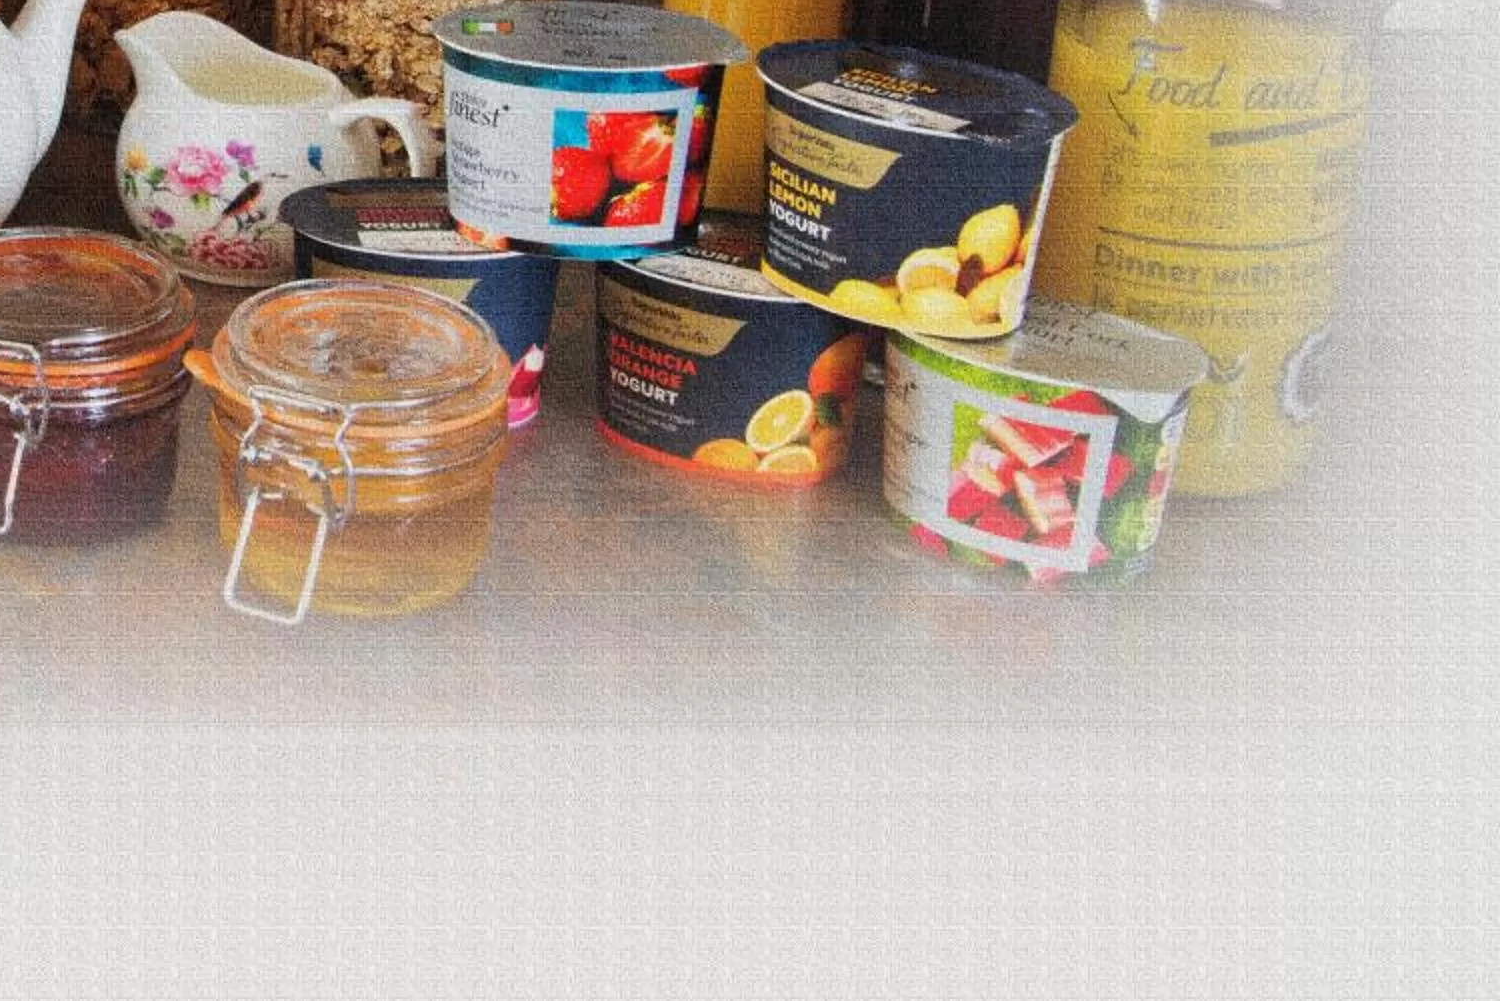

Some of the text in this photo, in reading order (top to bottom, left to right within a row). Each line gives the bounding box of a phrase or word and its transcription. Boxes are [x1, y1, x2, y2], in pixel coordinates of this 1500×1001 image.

[1117, 39, 1229, 110] Food
[769, 179, 821, 218] LEMON
[770, 161, 835, 202] SICILIAN
[769, 198, 829, 239] YOGURT
[1093, 242, 1203, 285] Dinner
[610, 334, 695, 373] VALENCIA
[610, 351, 681, 387] ORANGE
[609, 366, 677, 404] YOGURT
